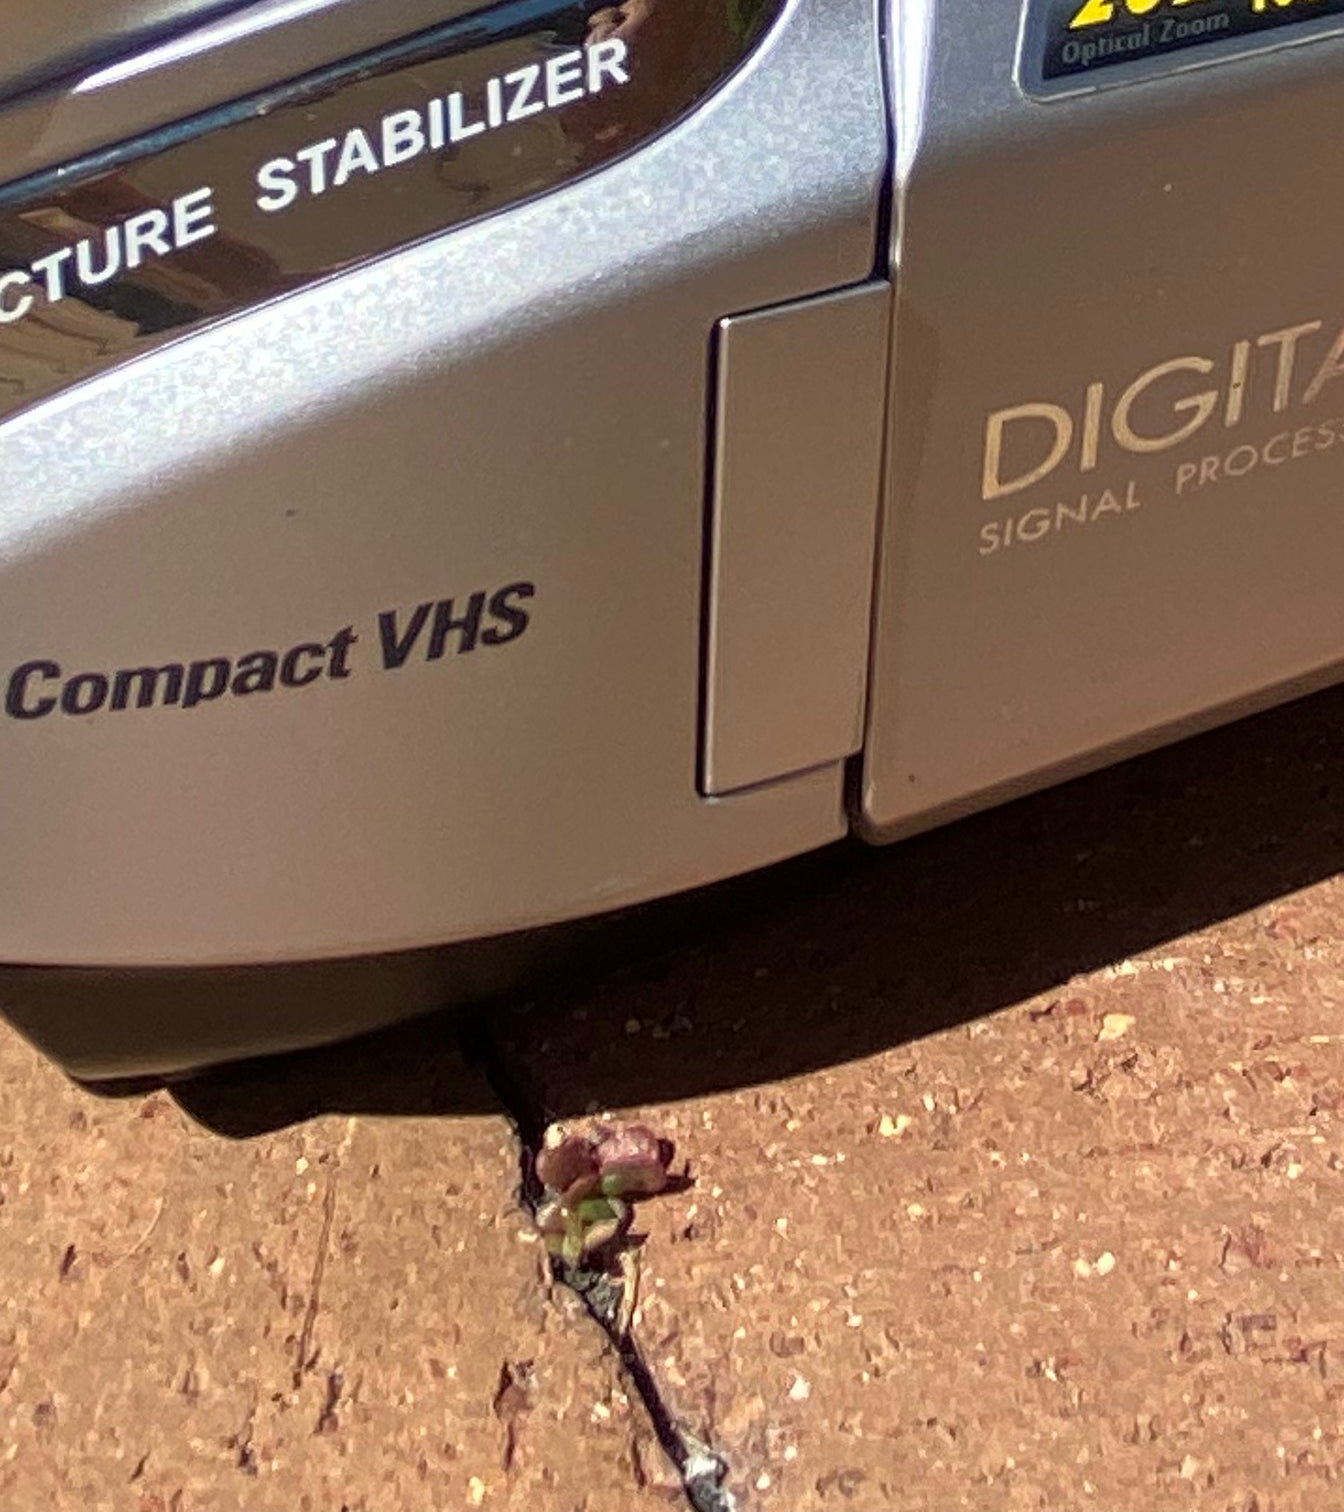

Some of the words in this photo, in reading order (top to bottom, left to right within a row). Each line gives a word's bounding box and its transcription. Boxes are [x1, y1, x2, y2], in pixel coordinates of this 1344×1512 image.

[1061, 21, 1151, 68] Optical
[1158, 10, 1230, 45] Zoom
[256, 38, 630, 212] STABILIZER
[979, 481, 1142, 555] SIGNAL
[5, 626, 358, 719] Compact
[378, 582, 537, 670] VHS
